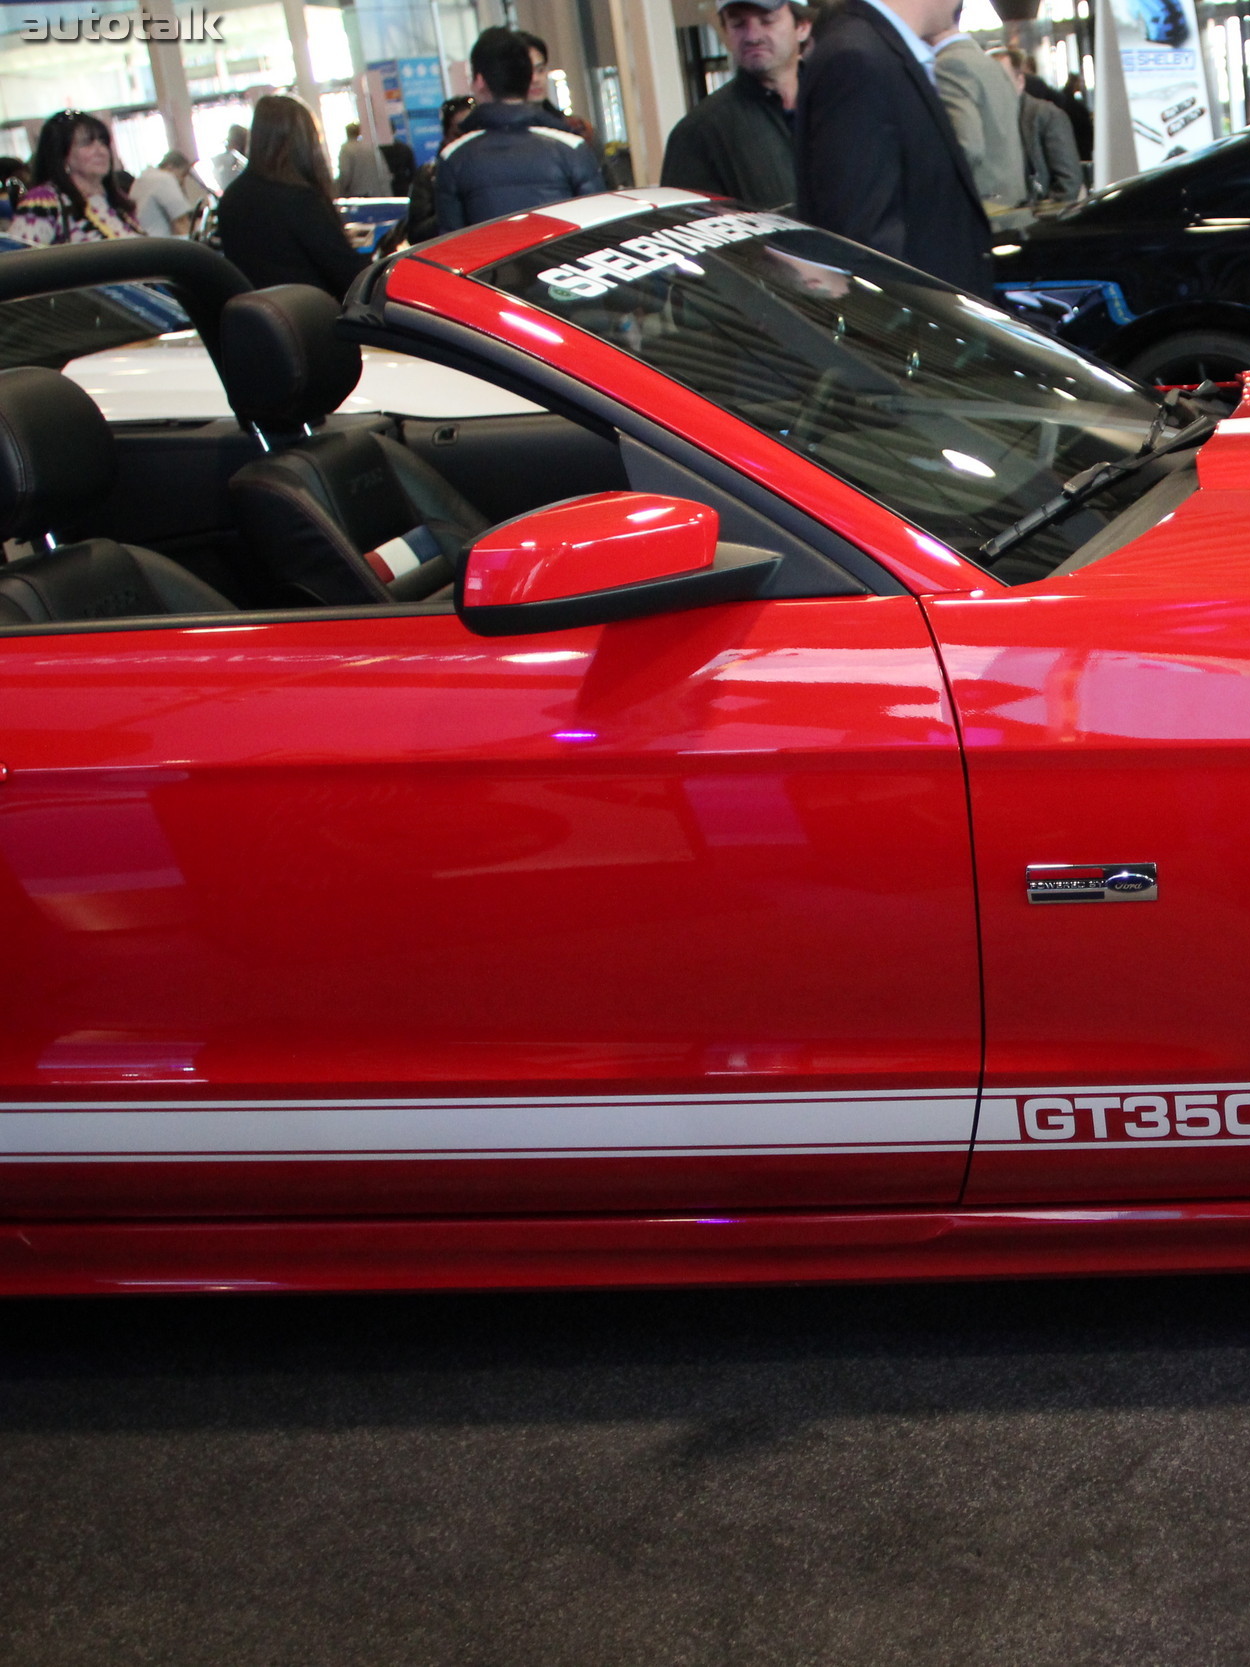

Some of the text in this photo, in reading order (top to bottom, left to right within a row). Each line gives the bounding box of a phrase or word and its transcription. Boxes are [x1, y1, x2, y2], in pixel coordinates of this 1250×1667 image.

[1138, 53, 1190, 65] SHELBY
[1029, 880, 1143, 890] POWERED BY Ford
